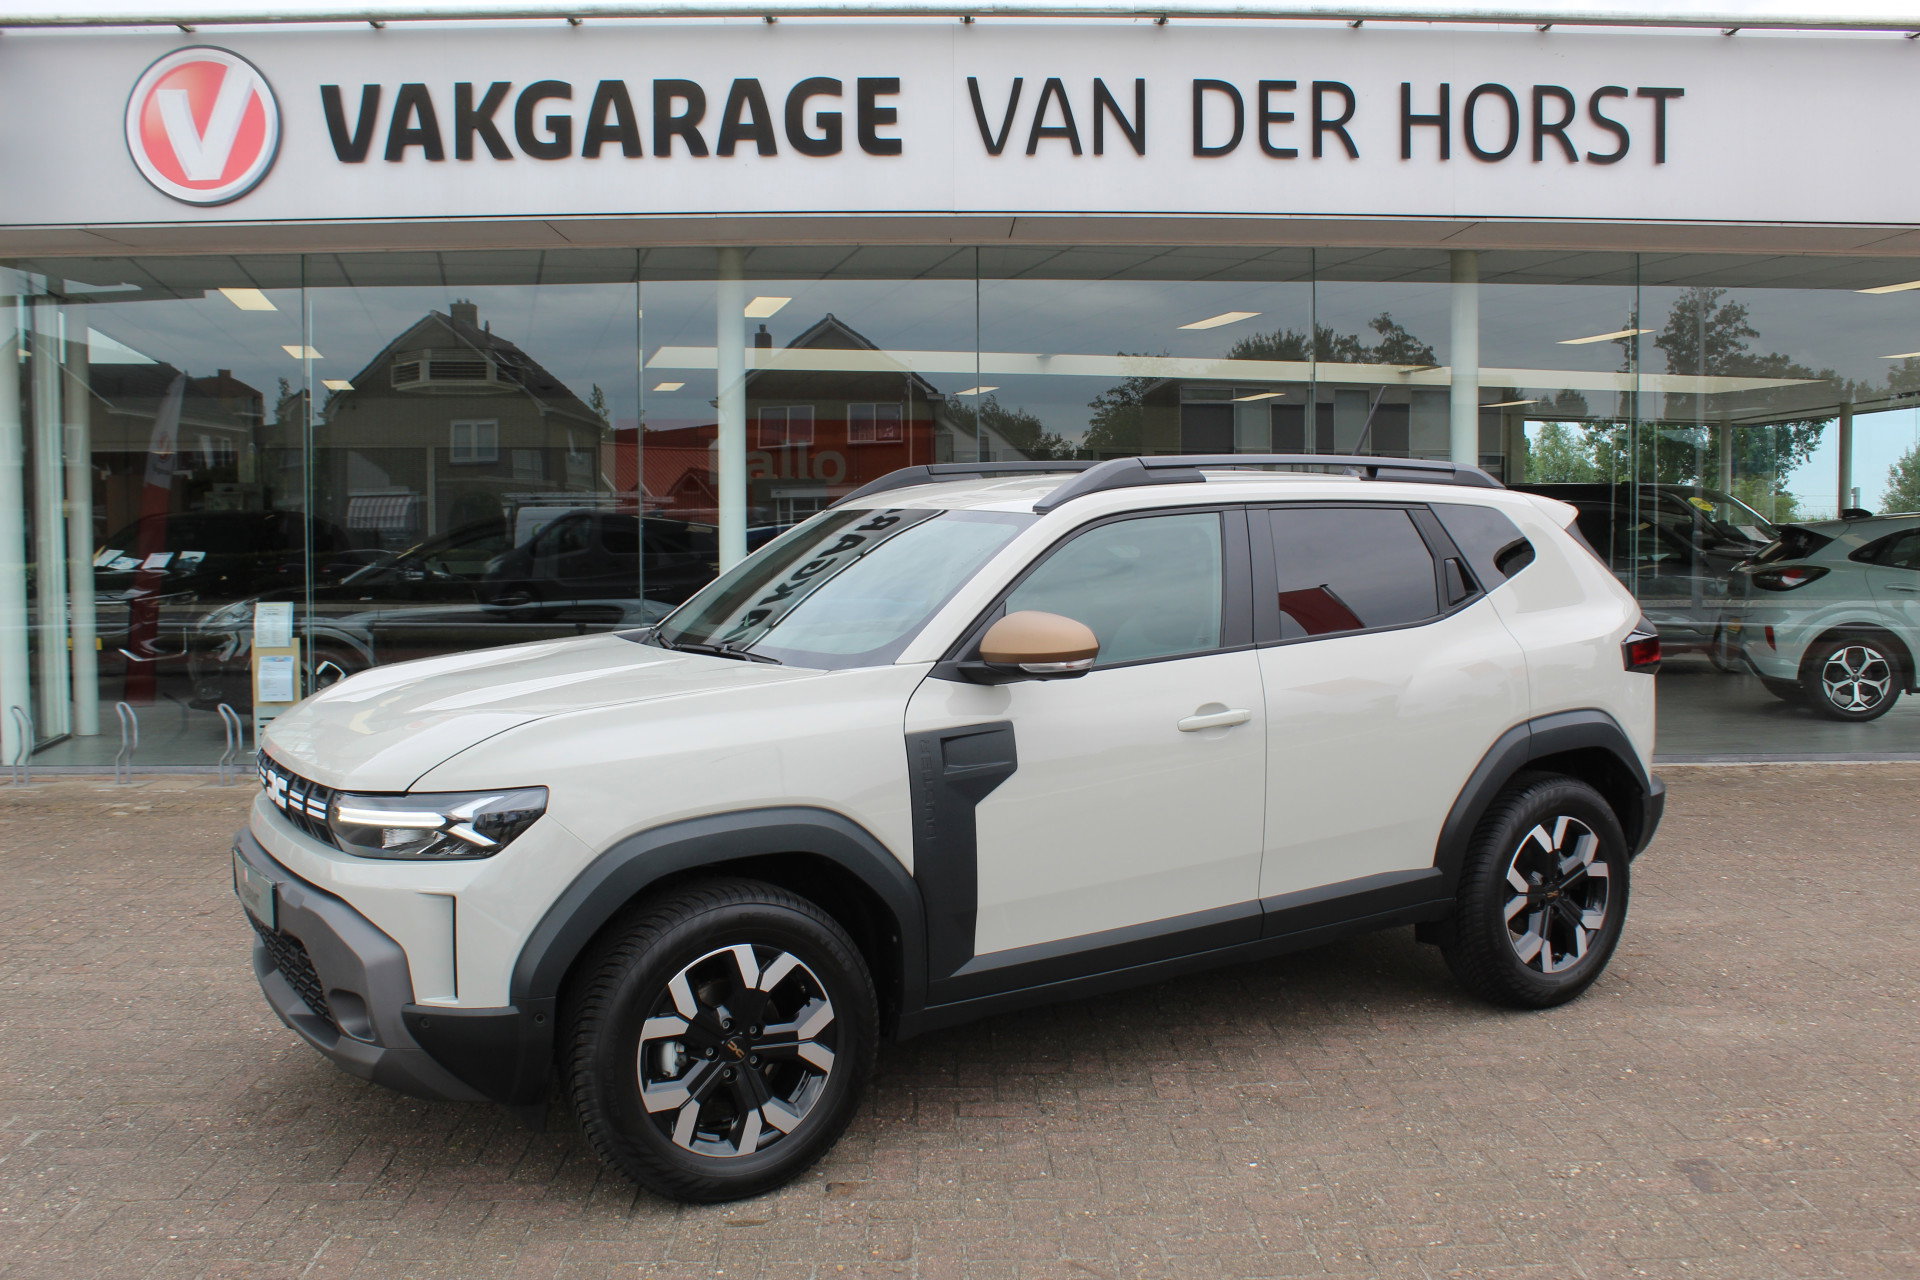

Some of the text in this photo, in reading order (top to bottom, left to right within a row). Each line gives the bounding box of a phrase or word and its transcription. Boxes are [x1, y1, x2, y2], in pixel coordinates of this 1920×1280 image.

[321, 77, 1684, 165] VAKGARAGE VAN DER HORST
